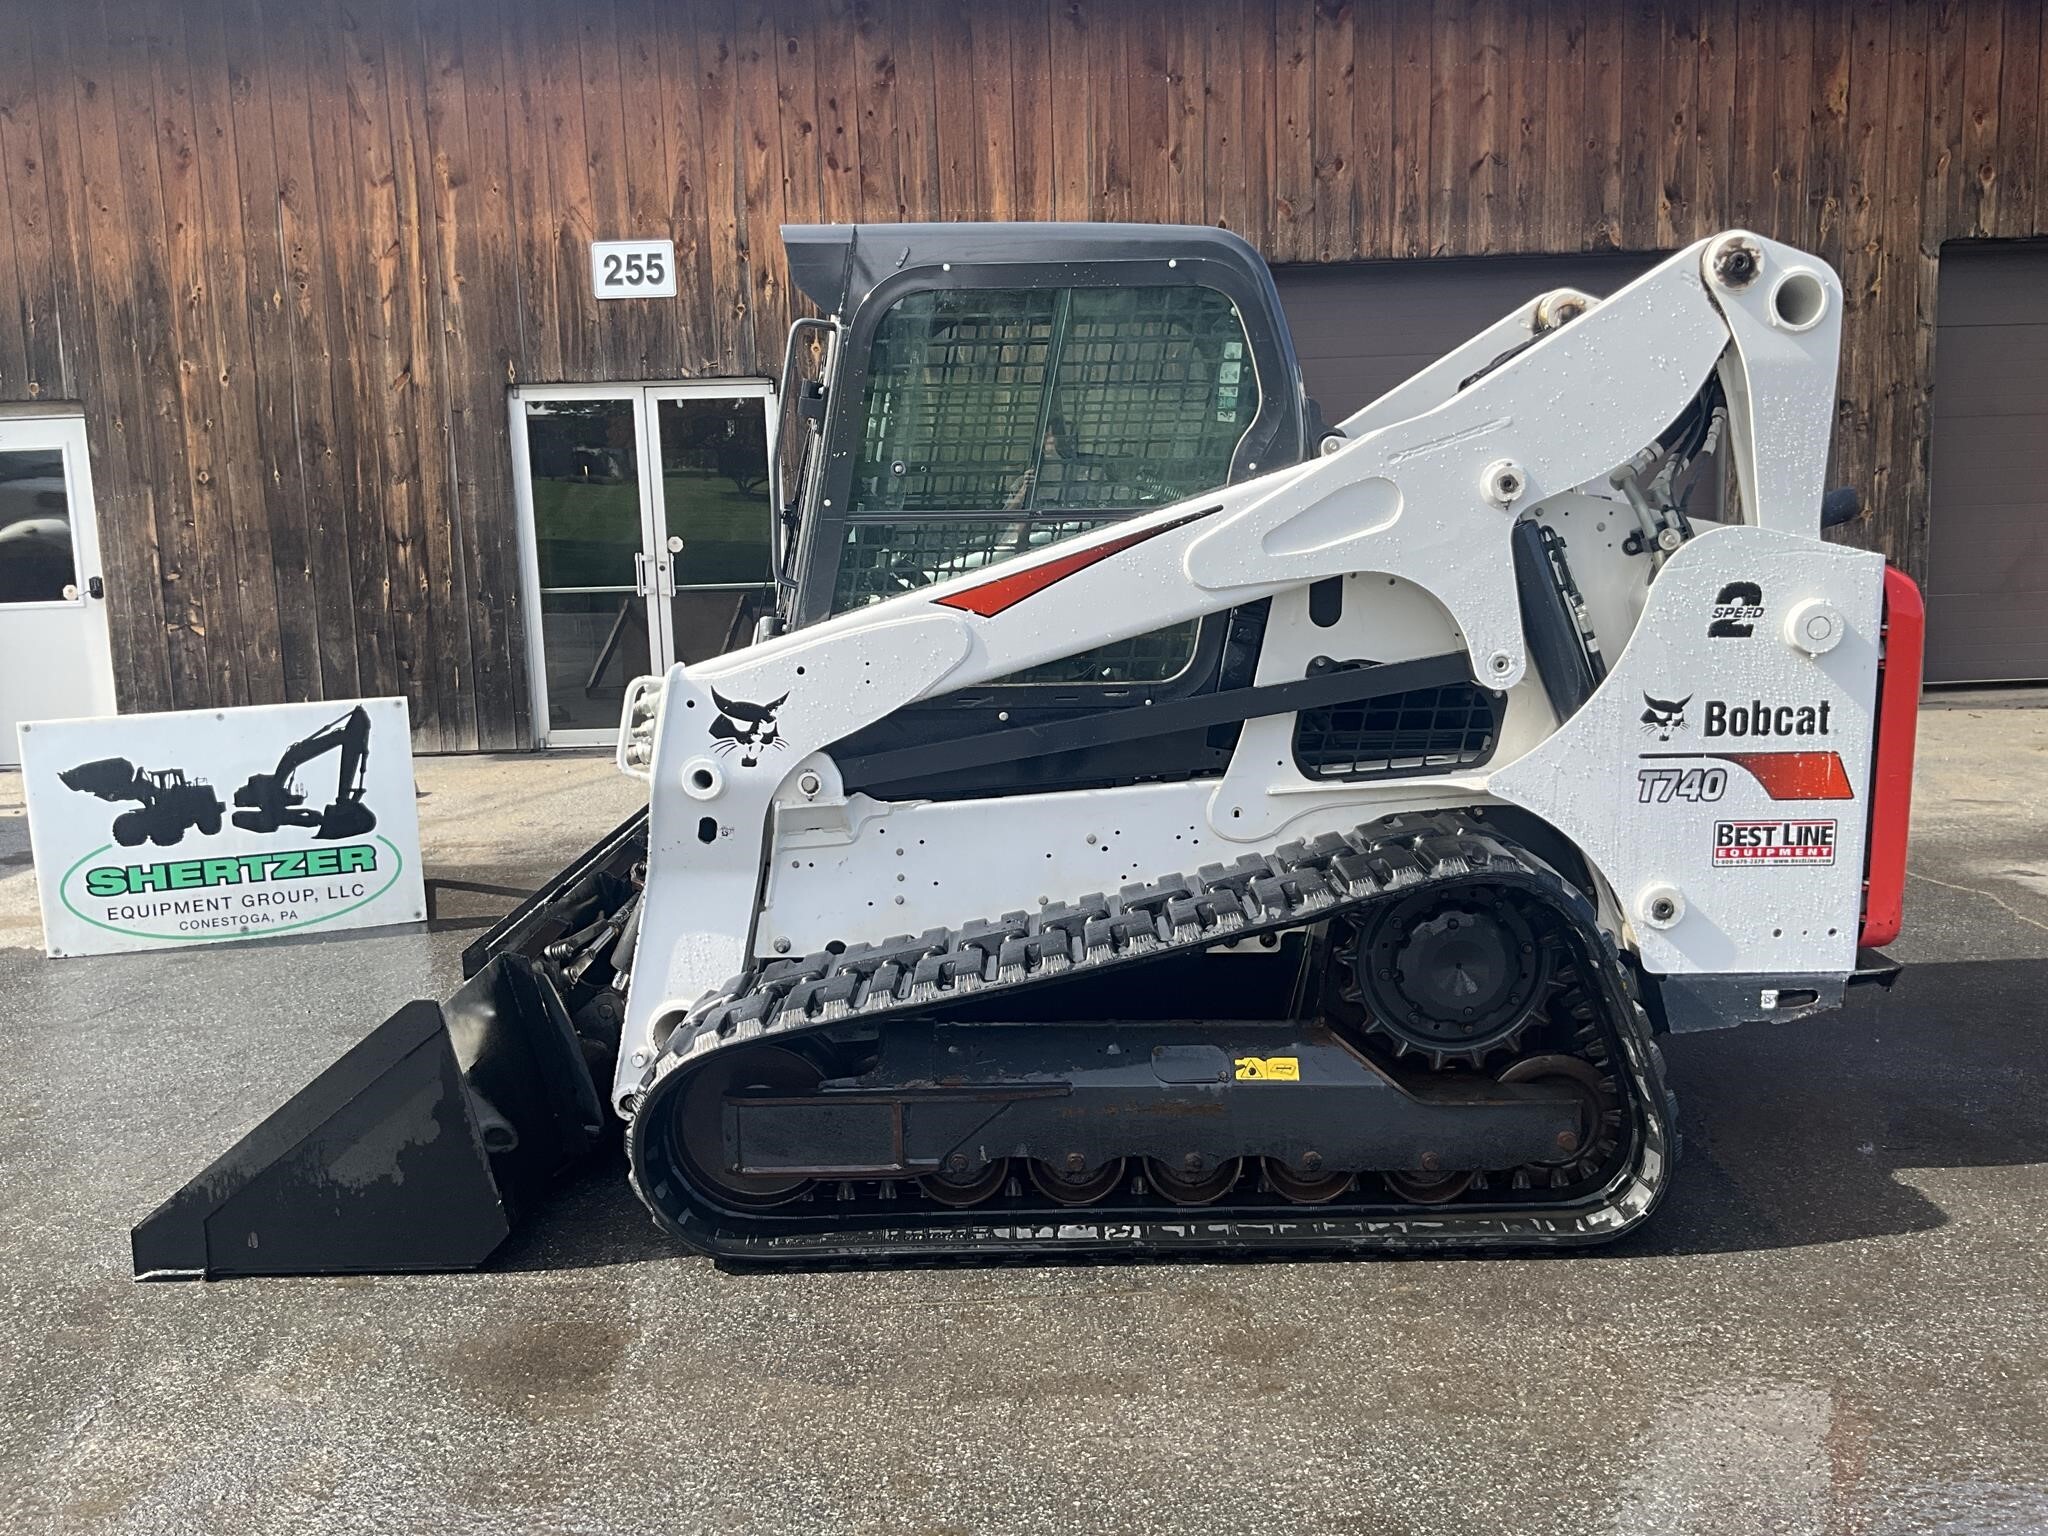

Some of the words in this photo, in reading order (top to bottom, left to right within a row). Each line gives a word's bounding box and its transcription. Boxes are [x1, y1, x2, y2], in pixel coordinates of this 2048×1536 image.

[603, 253, 665, 286] 255
[1707, 581, 1762, 638] 2
[1711, 607, 1765, 619] SPEED
[1703, 699, 1830, 737] Bobcat
[1638, 768, 1728, 803] T740
[1716, 823, 1776, 847] BEST
[1783, 823, 1833, 846] LINE
[1718, 848, 1830, 857] EQUIPMENT
[86, 844, 377, 897] SHERTZER
[107, 896, 232, 920] EQUIPMENT
[241, 888, 318, 908] GROUP,
[327, 883, 364, 899] LLC
[179, 913, 275, 931] CONESTOGA,
[280, 910, 298, 921] PA
